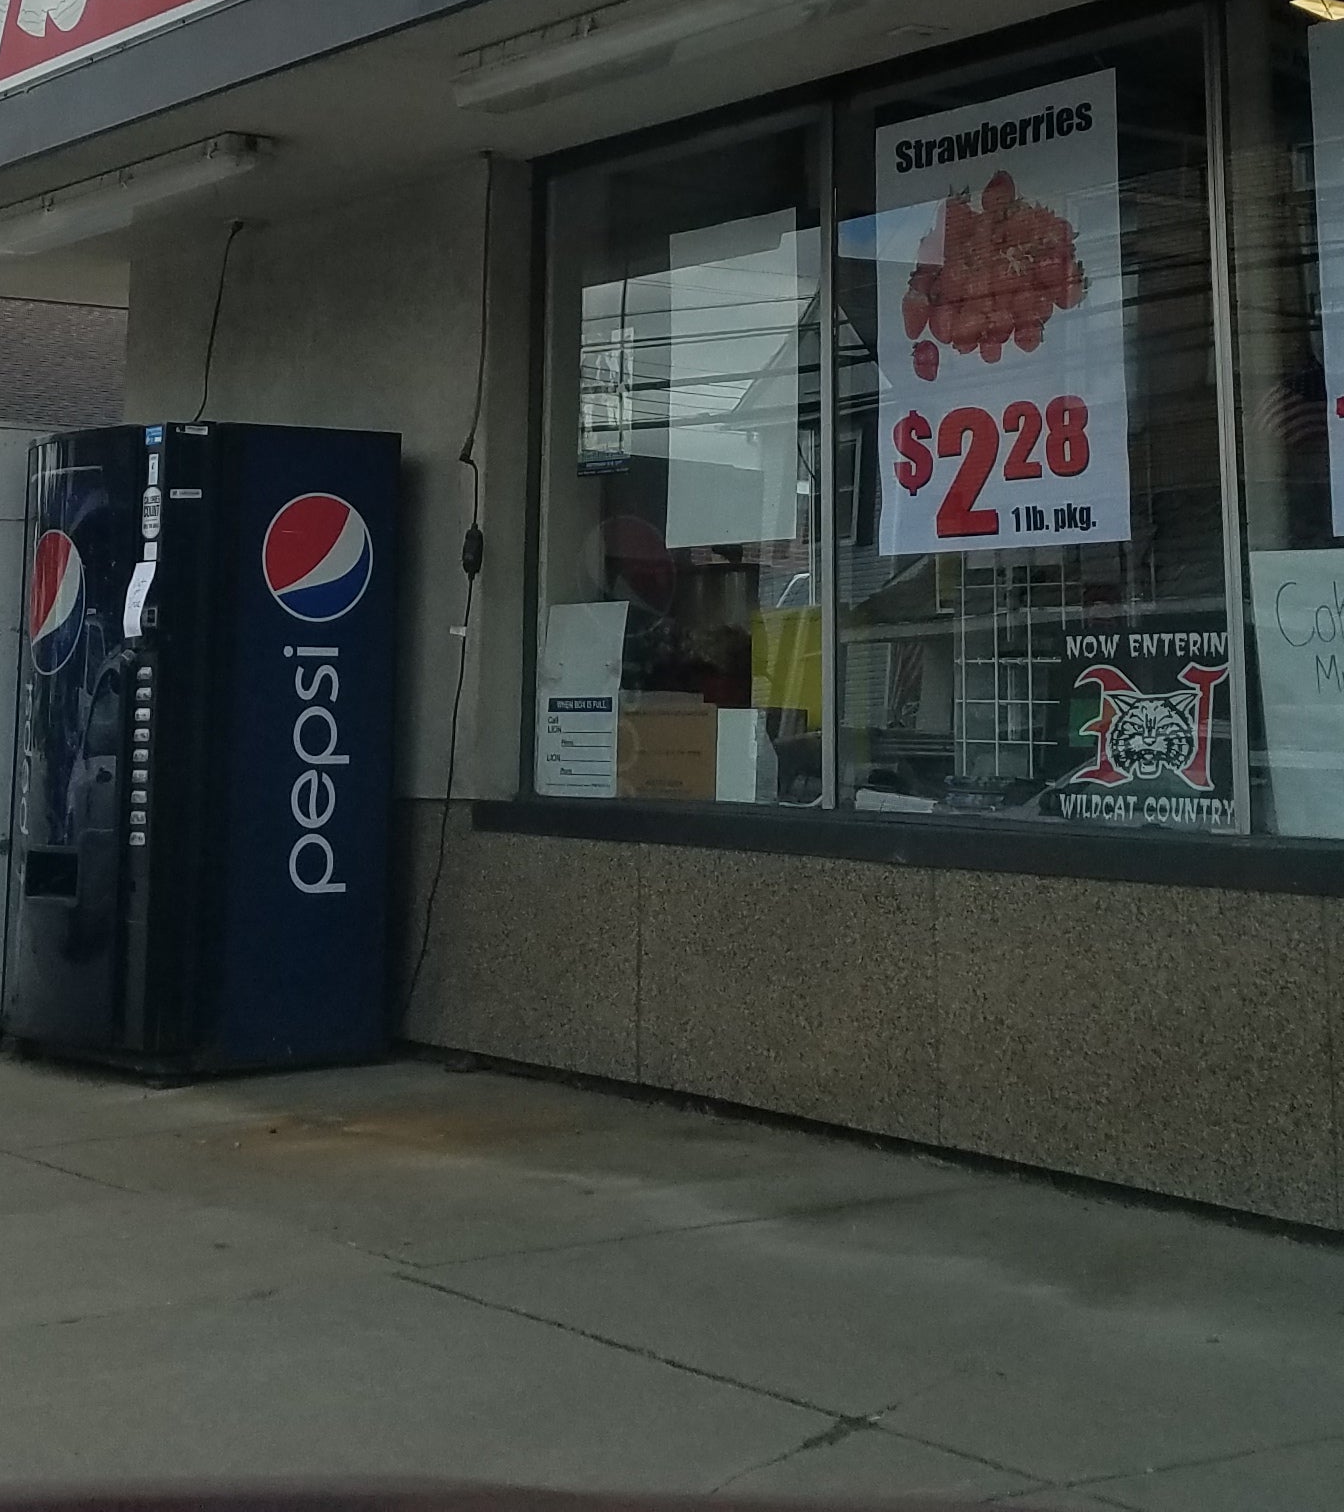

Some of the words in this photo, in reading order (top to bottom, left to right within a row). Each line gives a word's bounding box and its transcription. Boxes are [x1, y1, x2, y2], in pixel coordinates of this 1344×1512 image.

[895, 102, 1093, 173] Strawberries
[1024, 505, 1050, 531] lb.
[1054, 503, 1097, 532] pkg.
[1066, 634, 1120, 659] NOW
[1129, 632, 1228, 657] ENTERIN
[284, 643, 350, 894] pepsi
[1060, 793, 1138, 820] WILDCAT
[1144, 796, 1235, 826] COUNTRY
